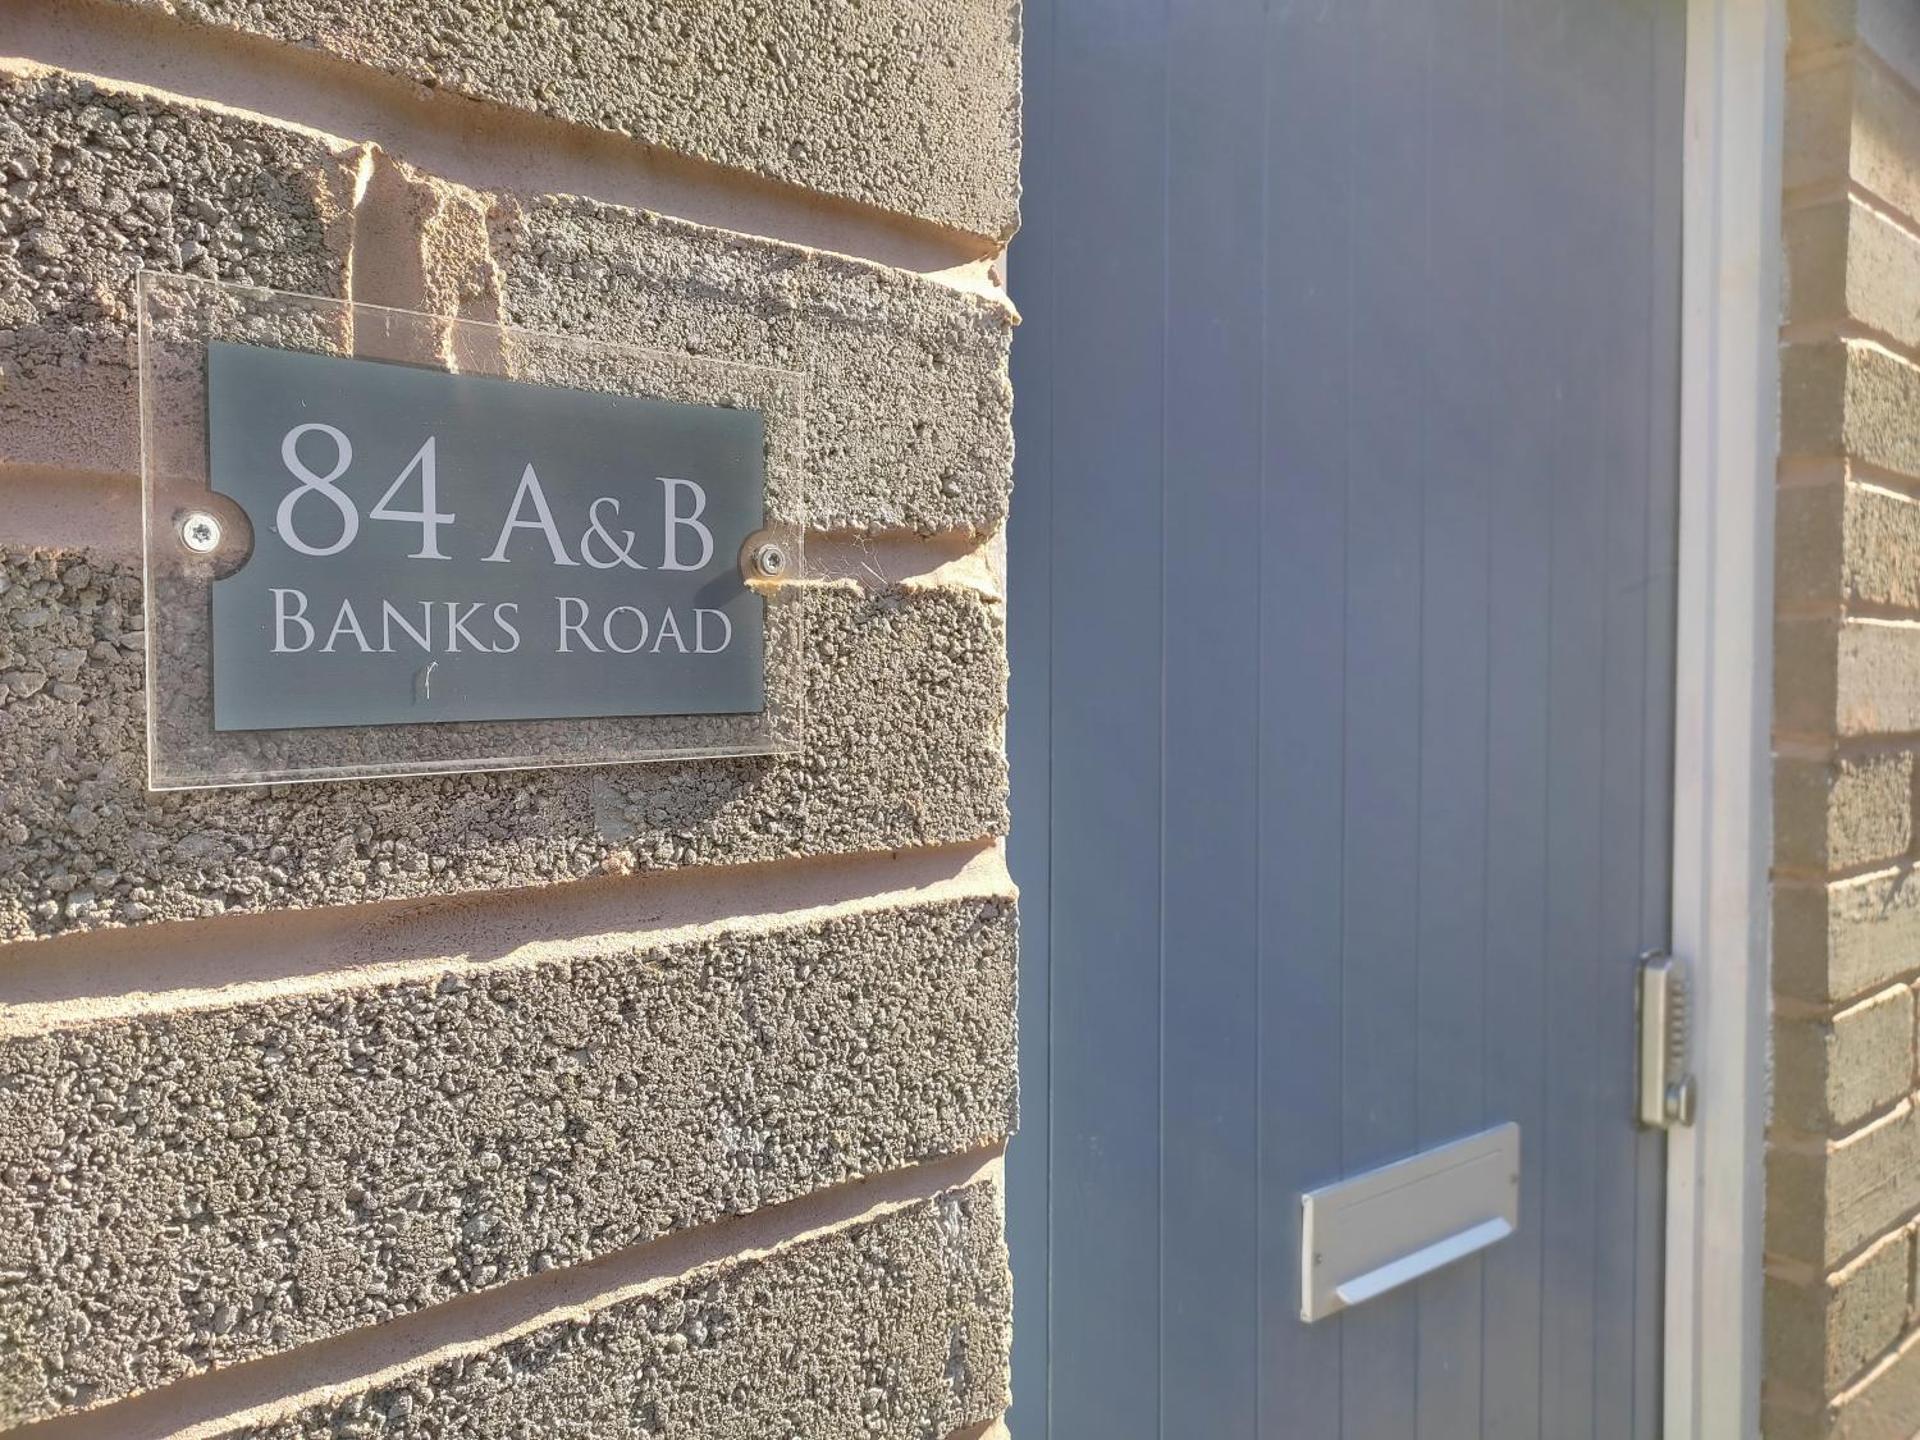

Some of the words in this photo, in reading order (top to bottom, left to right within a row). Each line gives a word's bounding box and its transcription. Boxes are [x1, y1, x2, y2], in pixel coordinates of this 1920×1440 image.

[275, 423, 456, 560] 84
[268, 588, 521, 654] BANKS
[555, 597, 733, 654] ROAD
